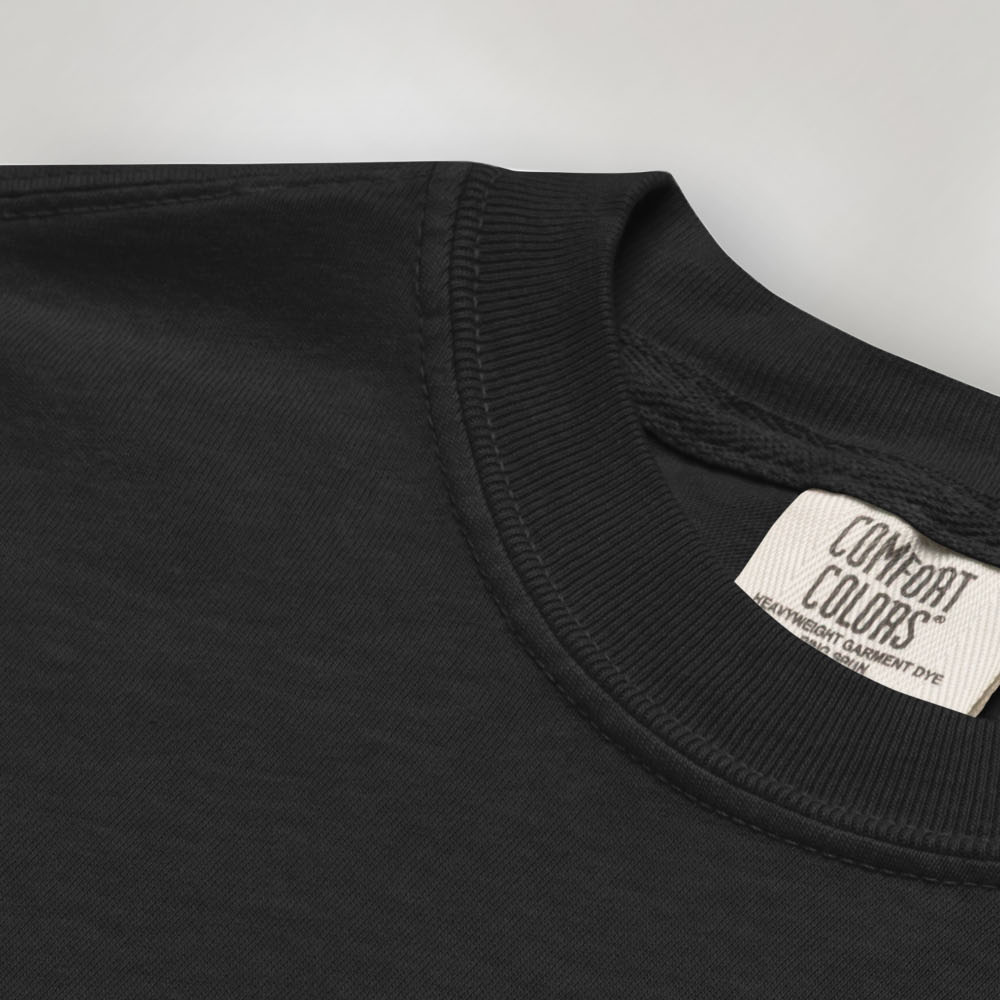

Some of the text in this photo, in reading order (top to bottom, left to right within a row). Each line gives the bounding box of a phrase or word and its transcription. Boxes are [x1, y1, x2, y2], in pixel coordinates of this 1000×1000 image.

[829, 515, 978, 613] COMFORT
[753, 592, 945, 686] HEAVYWEIGHT GARMENT DYE
